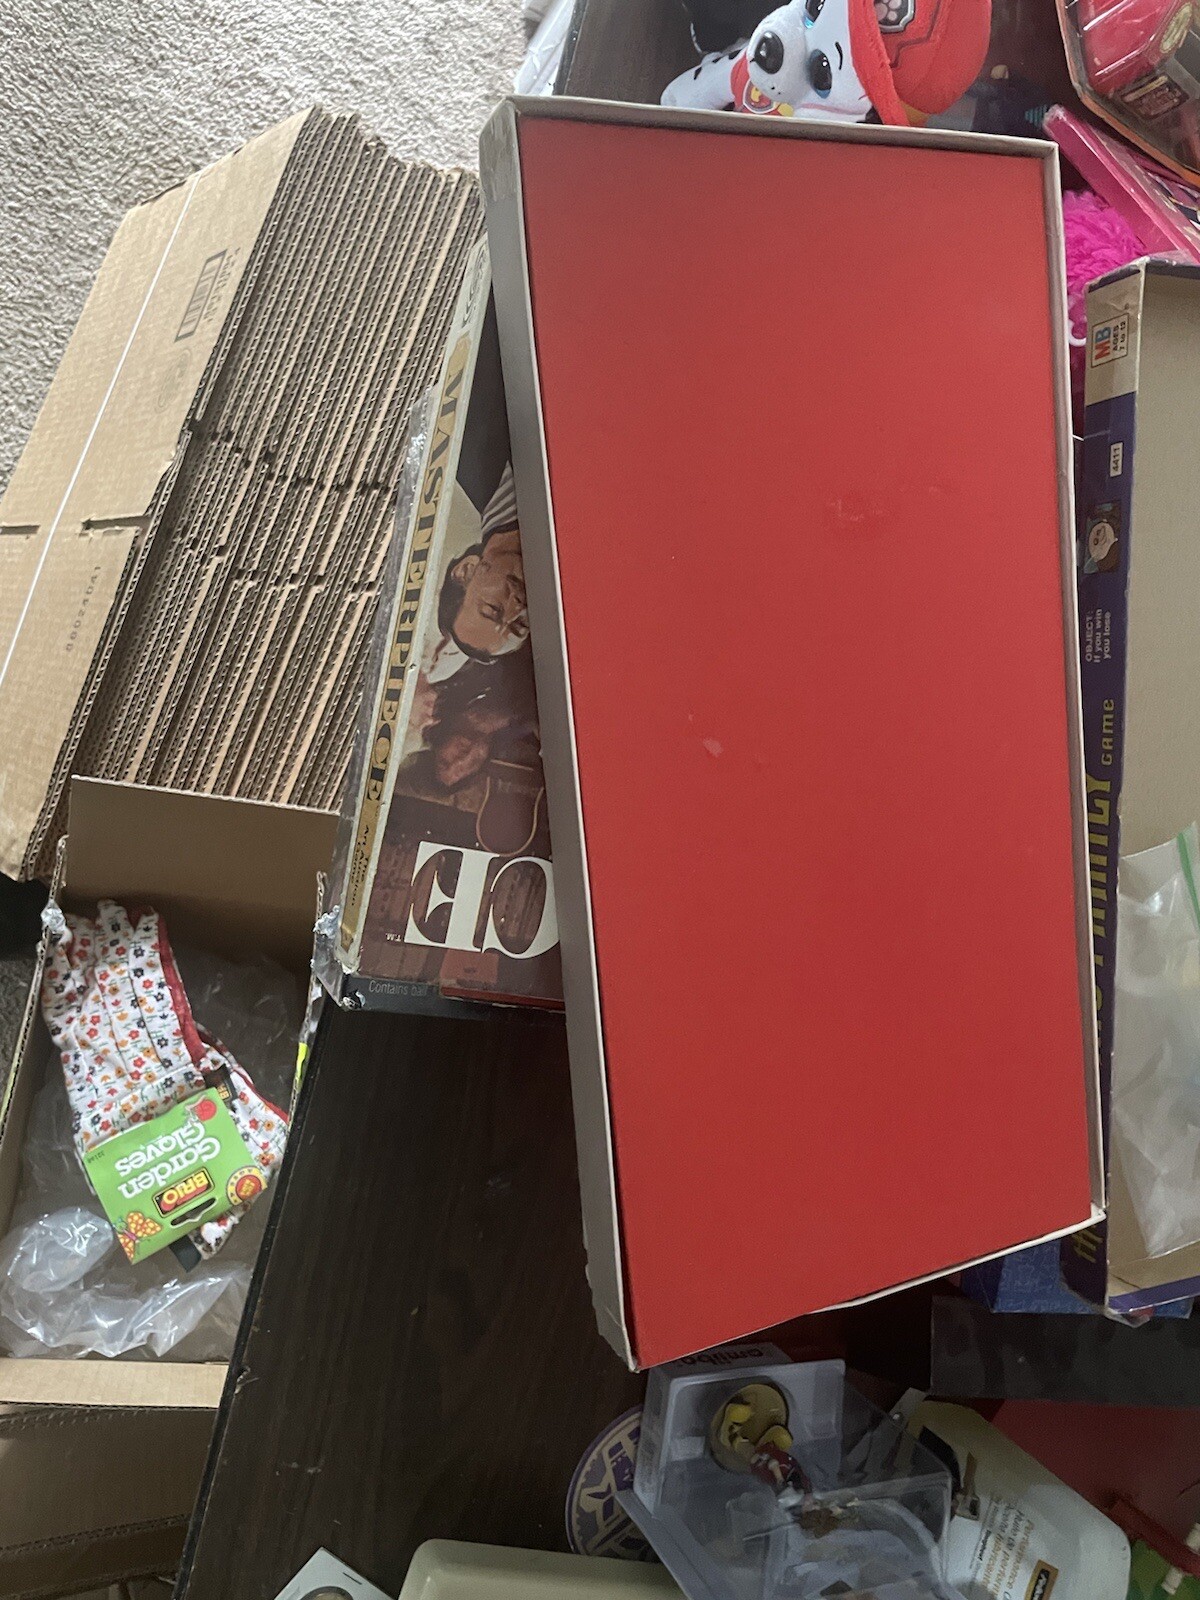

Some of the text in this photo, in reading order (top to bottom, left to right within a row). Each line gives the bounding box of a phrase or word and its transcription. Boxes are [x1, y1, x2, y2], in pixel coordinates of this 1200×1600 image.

[1094, 326, 1112, 361] MB
[1112, 324, 1120, 352] AGES
[1112, 447, 1120, 472] 4411
[357, 365, 473, 803] MASTERPIECE
[1095, 608, 1103, 629] win
[1094, 631, 1103, 652] you
[1103, 637, 1112, 660] you
[368, 979, 409, 996] Contains
[114, 1121, 206, 1177] Gloves
[118, 1137, 221, 1199] Garden
[162, 1170, 209, 1205] BRIO
